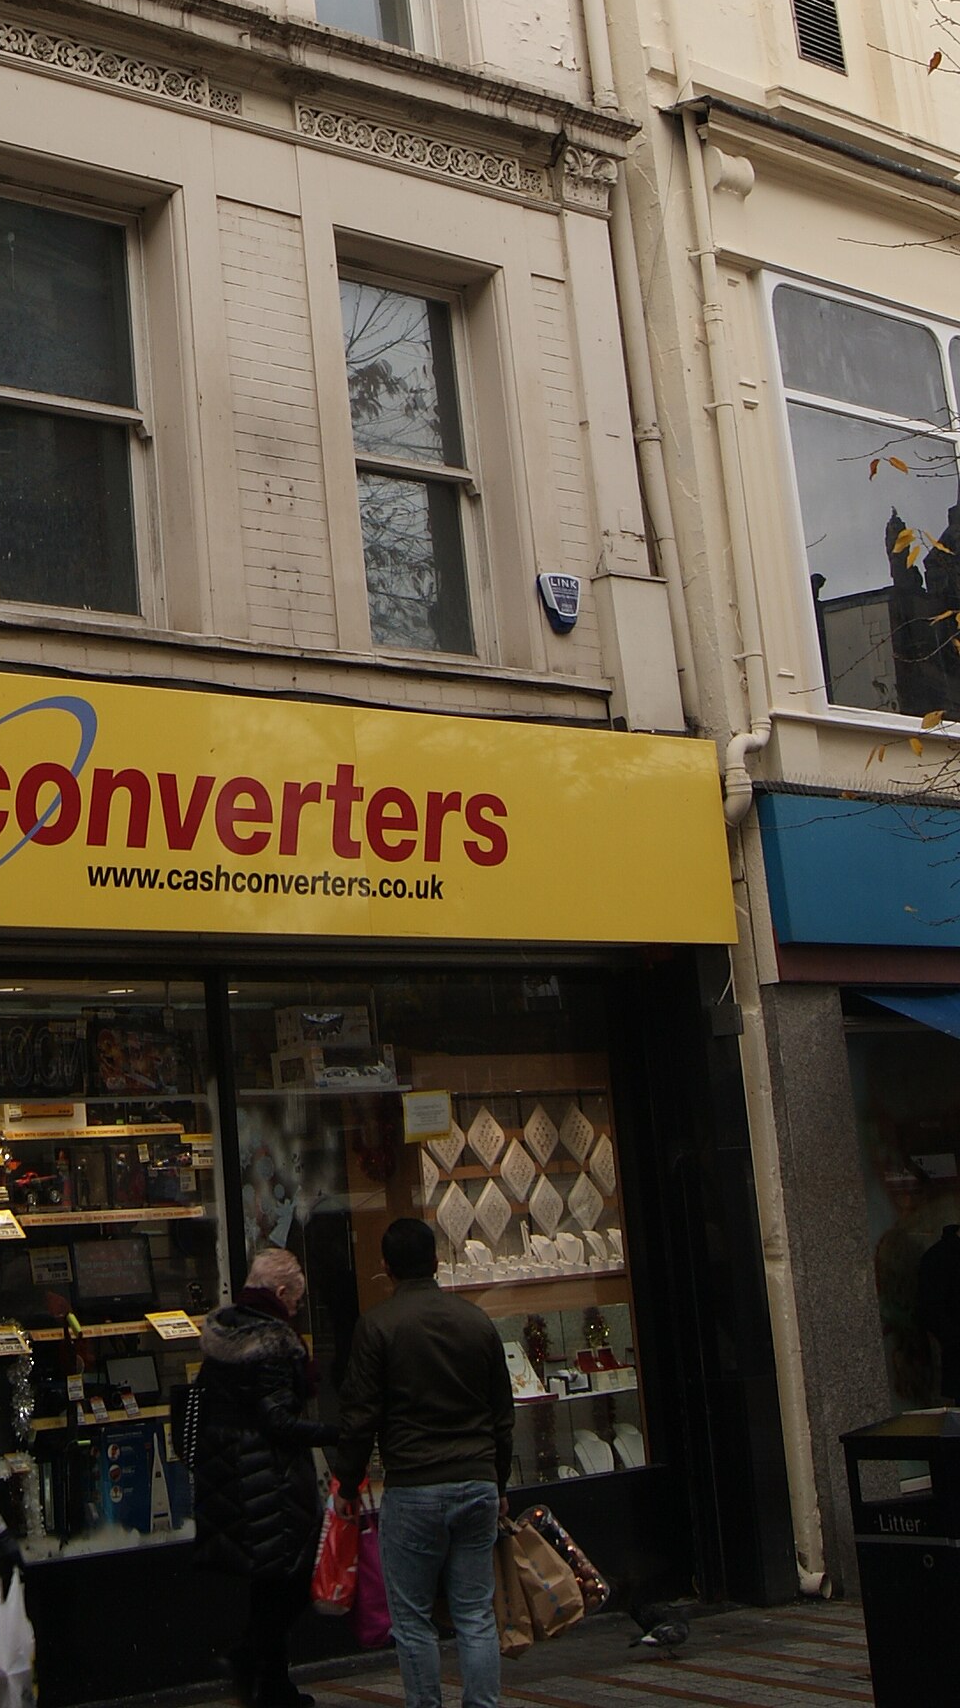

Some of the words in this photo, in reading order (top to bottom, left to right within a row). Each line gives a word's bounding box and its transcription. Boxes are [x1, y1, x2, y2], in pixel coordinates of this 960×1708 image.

[550, 578, 577, 589] LINK
[87, 864, 444, 900] www.cashconverters.co.uk
[879, 1513, 921, 1532] Litter
